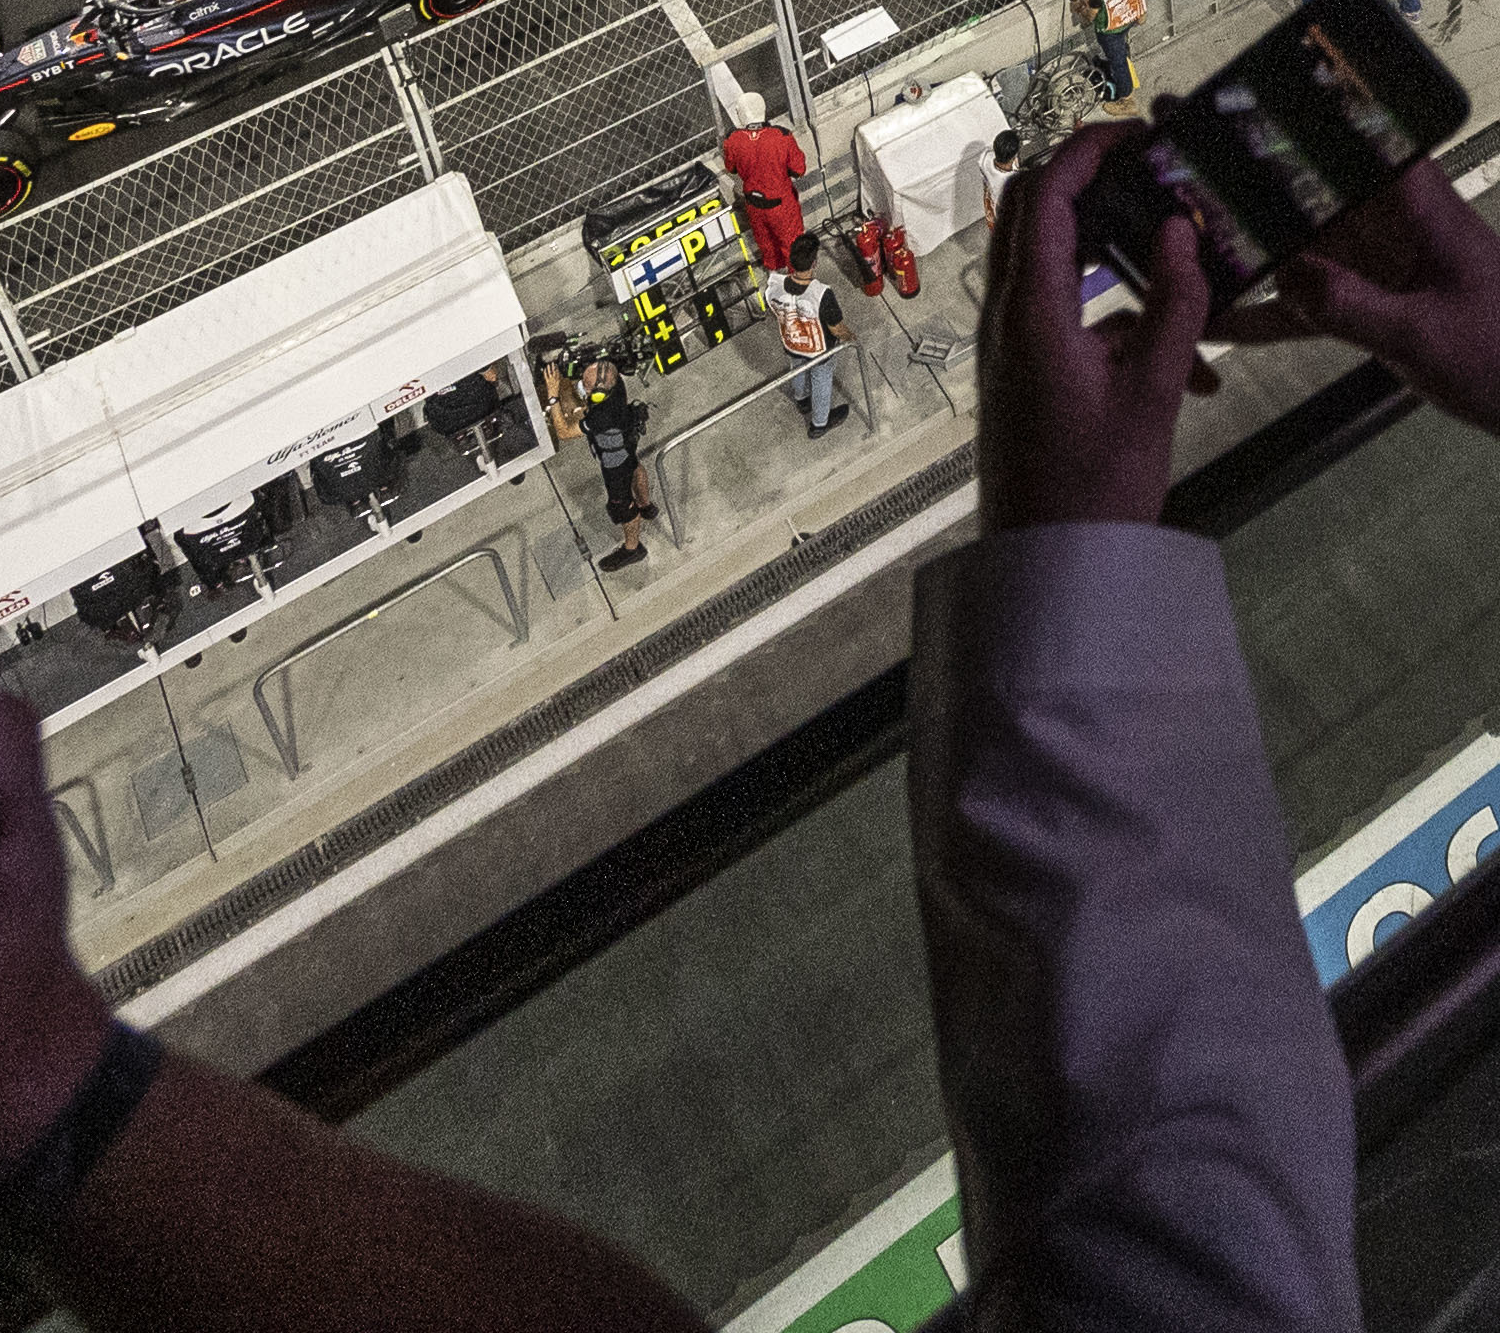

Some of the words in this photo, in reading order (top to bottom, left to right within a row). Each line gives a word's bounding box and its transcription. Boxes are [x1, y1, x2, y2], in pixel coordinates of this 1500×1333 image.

[189, 1, 221, 21] citrix
[149, 12, 310, 77] ORACLE
[31, 59, 75, 82] BYBIT
[681, 230, 706, 264] P
[640, 291, 666, 320] L
[386, 388, 424, 412] ORLEN
[310, 437, 335, 452] TEAM
